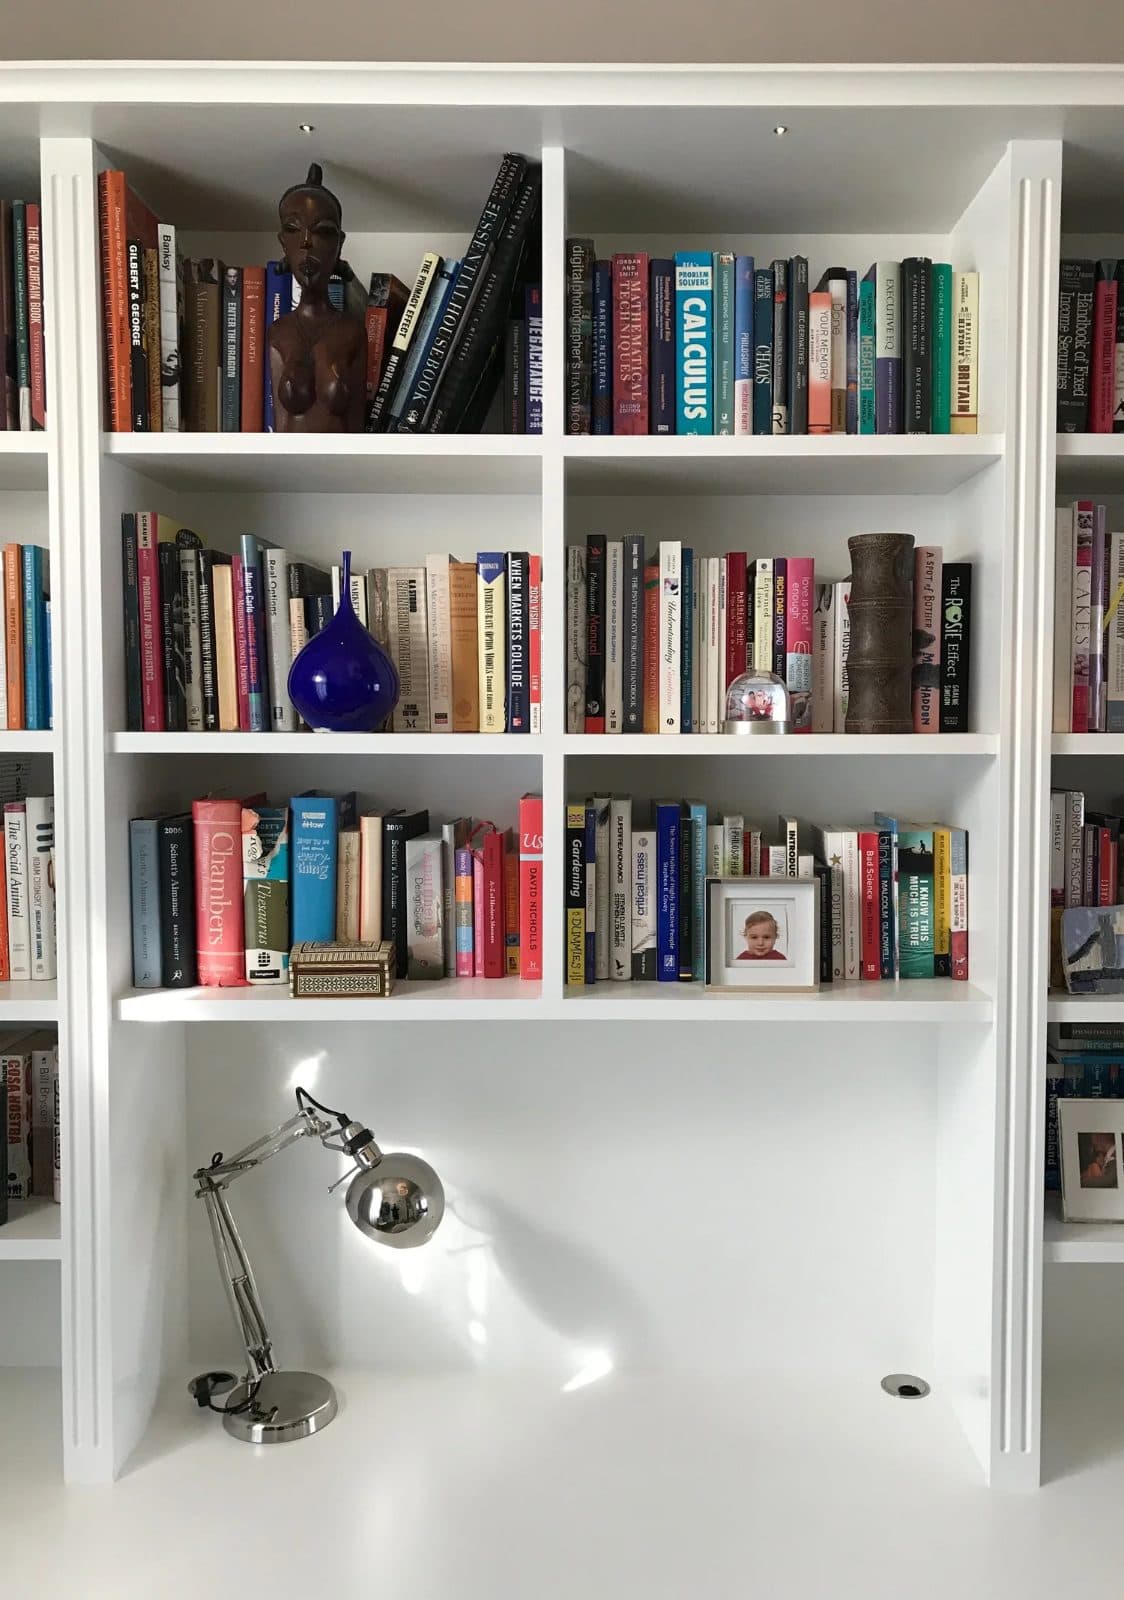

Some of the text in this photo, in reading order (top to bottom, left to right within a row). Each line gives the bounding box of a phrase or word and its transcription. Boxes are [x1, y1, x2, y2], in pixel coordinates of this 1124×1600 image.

[27, 225, 41, 324] THE NEW CURTAIN BOOK
[161, 234, 173, 271] Banksy
[450, 209, 498, 301] ESSENTIAL
[129, 244, 141, 346] GILBERT & GEORGE
[398, 259, 433, 339] THE PRIMACY EFFECT
[570, 245, 586, 369] digital photographer's
[678, 278, 709, 286] SOLVERS
[885, 278, 895, 335] EXECUTIVE
[227, 302, 237, 328] ENTER
[227, 328, 237, 343] THE
[619, 280, 631, 382] TECHNIQUES
[631, 280, 643, 401] MATHEMATICAL
[1057, 291, 1075, 390] Income Securities
[1075, 291, 1093, 349] Handbook
[227, 344, 237, 378] DRAGON
[528, 316, 543, 402] MEGACHANGE
[683, 297, 708, 420] CALCULUS
[755, 344, 772, 384] CHAOS
[797, 324, 805, 365] DERIVATIVES
[820, 310, 829, 380] YOUR MEMORY
[861, 335, 873, 390] MEGATECH
[379, 354, 400, 393] MICHAEL
[957, 364, 971, 412] BRITAIN
[1072, 366, 1089, 397] Fixed
[369, 395, 385, 419] SHEA
[776, 576, 784, 596] RICH
[801, 576, 811, 597] love
[925, 560, 934, 582] SPOT
[949, 577, 961, 596] The
[143, 575, 154, 681] PROBABILITY AND STATISTICS
[511, 559, 522, 688] WHEN MARKETS COLLIDE
[531, 586, 540, 630] 2020 VISION
[589, 572, 601, 657] Publication Manual
[776, 597, 784, 614] DAD
[790, 582, 801, 619] enough
[801, 609, 811, 625] not
[924, 595, 936, 628] BOTHER
[1075, 569, 1091, 646] CAKES
[664, 600, 678, 664] Understanding
[946, 643, 960, 678] Effect
[920, 685, 933, 726] HADDON
[1071, 799, 1081, 855] LORRAINE
[8, 820, 24, 919] The Social Animal
[169, 843, 180, 918] Schott's Almanac
[208, 832, 235, 945] Chambers
[635, 852, 646, 916] critical mass
[866, 850, 874, 900] Bad Science
[257, 881, 272, 945] Thesaurus
[529, 867, 538, 951] DAVID NICHOLLS
[570, 839, 583, 968] Gardening DUMMIES
[832, 893, 841, 946] OUTLIERS
[878, 836, 890, 963] blink MALCOLM GLADWELL
[909, 875, 919, 946] MUCH IS TRUE
[919, 886, 929, 917] KNOW
[919, 919, 929, 942] THIS
[8, 1060, 22, 1145] COSA NOSTRA
[39, 1067, 49, 1084] Bill
